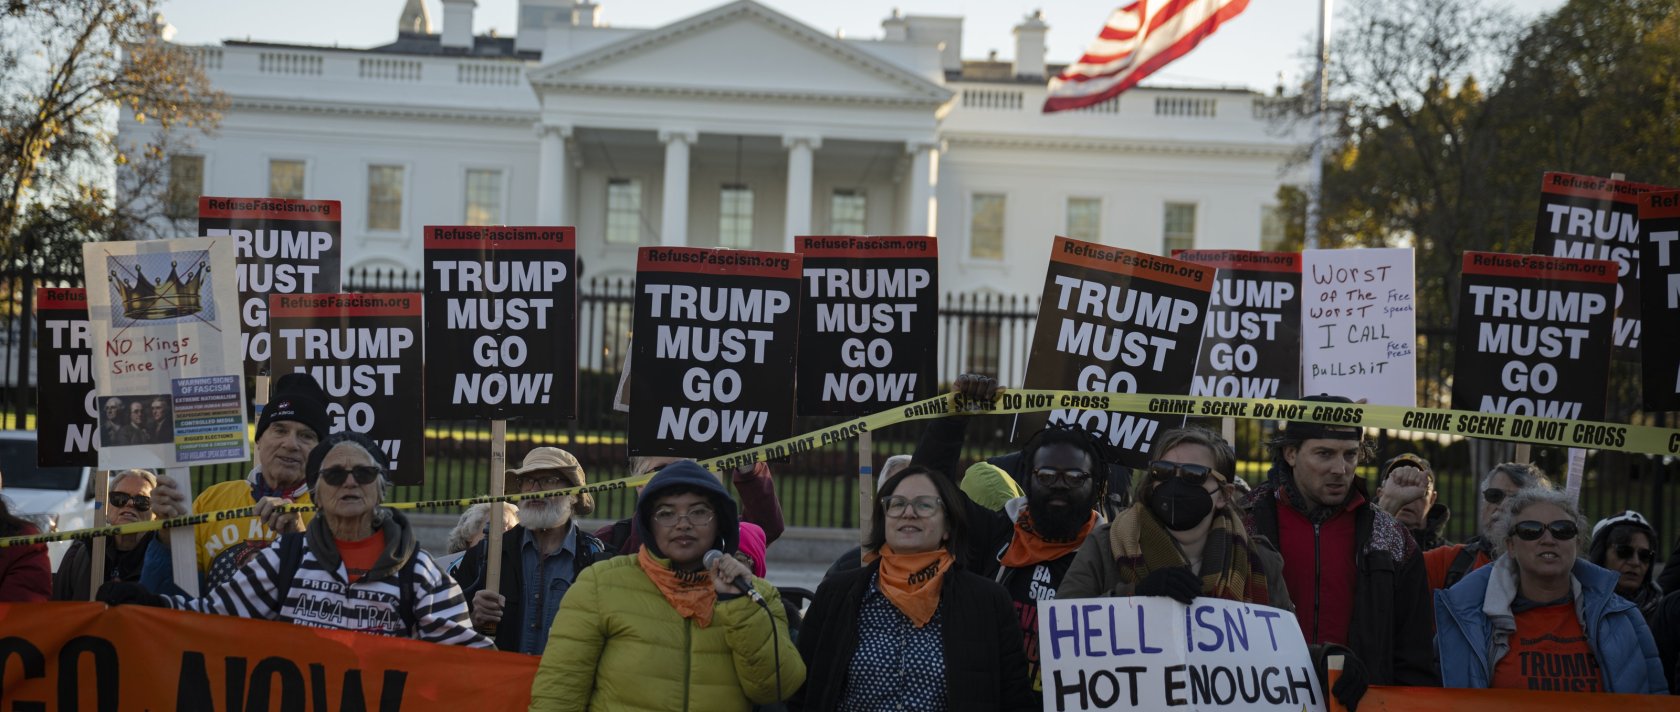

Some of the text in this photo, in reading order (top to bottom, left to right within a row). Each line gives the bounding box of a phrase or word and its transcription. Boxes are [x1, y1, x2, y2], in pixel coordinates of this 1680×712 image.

[208, 200, 331, 214] RefuseFascism.org
[434, 228, 564, 242] RefuseFascism.org
[804, 238, 927, 251] RefuseFascism.org
[648, 250, 790, 270] RefuseFascism.org
[1063, 240, 1203, 282] RefuseFascism.org
[1180, 252, 1294, 266] RefuseFascism.org
[1473, 254, 1606, 275] RefuseFascism.org
[432, 260, 567, 293] TRUMP
[803, 268, 931, 299] TRUMP
[281, 296, 410, 308] RefuseFascism.org
[644, 284, 791, 324] TRUMP
[1054, 274, 1199, 334] TRUMP
[1388, 289, 1411, 303] Free
[1469, 285, 1607, 324] TRUMP
[243, 298, 269, 327] G
[447, 298, 554, 330] MUST
[816, 303, 918, 333] MUST
[106, 336, 190, 357] NO Kings
[279, 328, 414, 360] TRUMP
[656, 324, 774, 364] MUST
[1056, 317, 1177, 372] MUST
[1318, 323, 1390, 349] I CALL
[1478, 322, 1590, 360] MUST
[112, 360, 155, 375] Since
[163, 353, 199, 370] 1776
[473, 335, 528, 368] GO
[841, 338, 893, 368] GO
[1210, 343, 1258, 372] GO
[181, 384, 231, 394] OF FASCISM
[213, 376, 234, 384] SIGNS
[452, 372, 554, 405] NOW!
[682, 366, 742, 404] GO
[822, 372, 917, 403] NOW!
[1077, 364, 1138, 394] GO
[1192, 375, 1280, 399] NOW!
[1501, 360, 1558, 394] GO
[1003, 393, 1022, 410] DO
[1026, 394, 1055, 409] NOT
[1060, 394, 1110, 409] CROSS
[1149, 398, 1364, 423] CRIME SCENE DO NOT CROSS
[656, 406, 769, 444] NOW!
[1402, 410, 1627, 447] CRIME SCENE DO NOT CROSS
[716, 452, 760, 472] SCENE
[766, 445, 785, 461] DO
[788, 437, 815, 455] NOT
[820, 422, 868, 446] CROSS
[204, 523, 240, 557] NO
[1032, 564, 1051, 583] BA
[1028, 580, 1056, 600] Spe
[1050, 604, 1163, 660] HELL
[1186, 605, 1281, 652] ISN'T
[1519, 651, 1599, 677] TRUMP
[1053, 666, 1148, 712] HOT
[1164, 664, 1317, 706] ENOUGH
